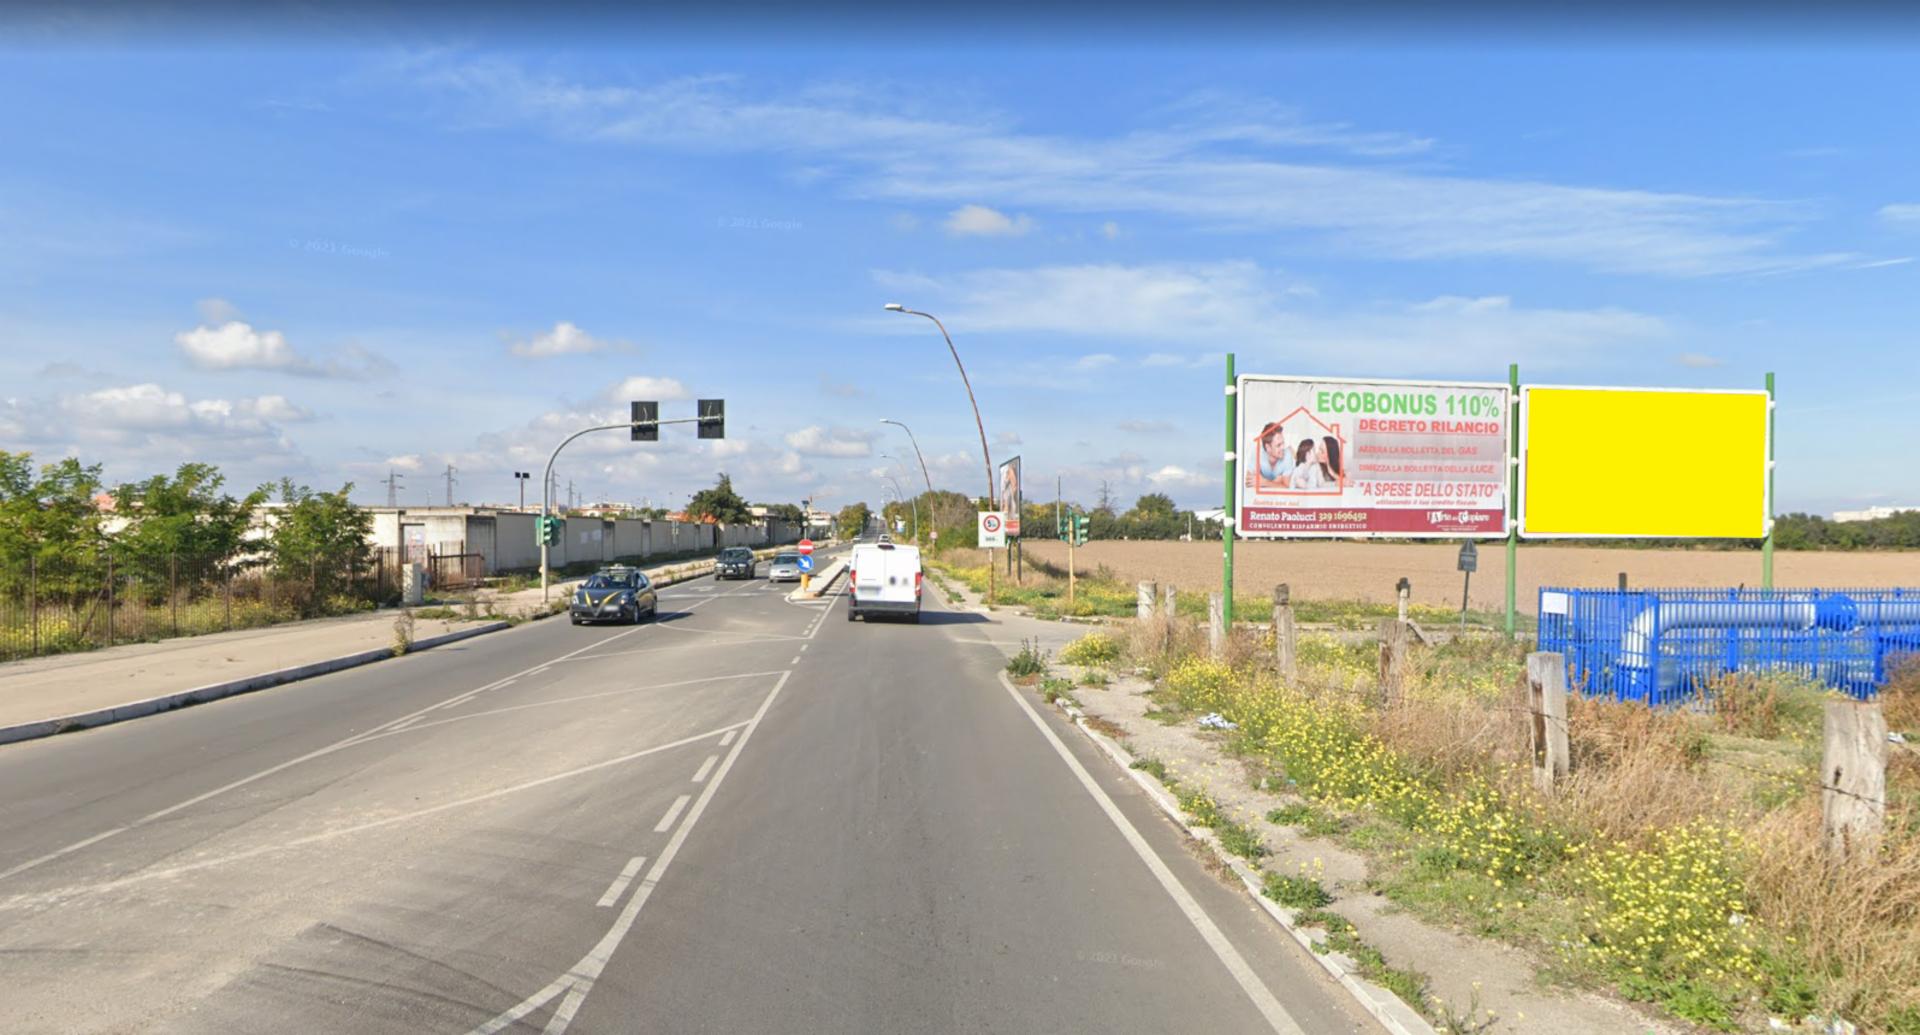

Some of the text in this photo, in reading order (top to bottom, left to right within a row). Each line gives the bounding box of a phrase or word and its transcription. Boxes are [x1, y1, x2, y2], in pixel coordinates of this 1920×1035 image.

[1317, 391, 1499, 417] ECOBONUS 110%
[1359, 419, 1499, 433] DECRETO RILANCIO
[1401, 446, 1440, 455] BOLLETTA
[1459, 446, 1478, 455] GAS
[1392, 464, 1402, 472] LA
[1404, 464, 1443, 473] BOLLETTA
[1445, 465, 1468, 473] DELLA
[1470, 464, 1495, 474] LUCE
[1360, 482, 1499, 498] "A SPESE DELLO STATO"
[1250, 511, 1280, 521] Renato
[1281, 511, 1316, 521] Paolucci
[1318, 512, 1332, 521] 329
